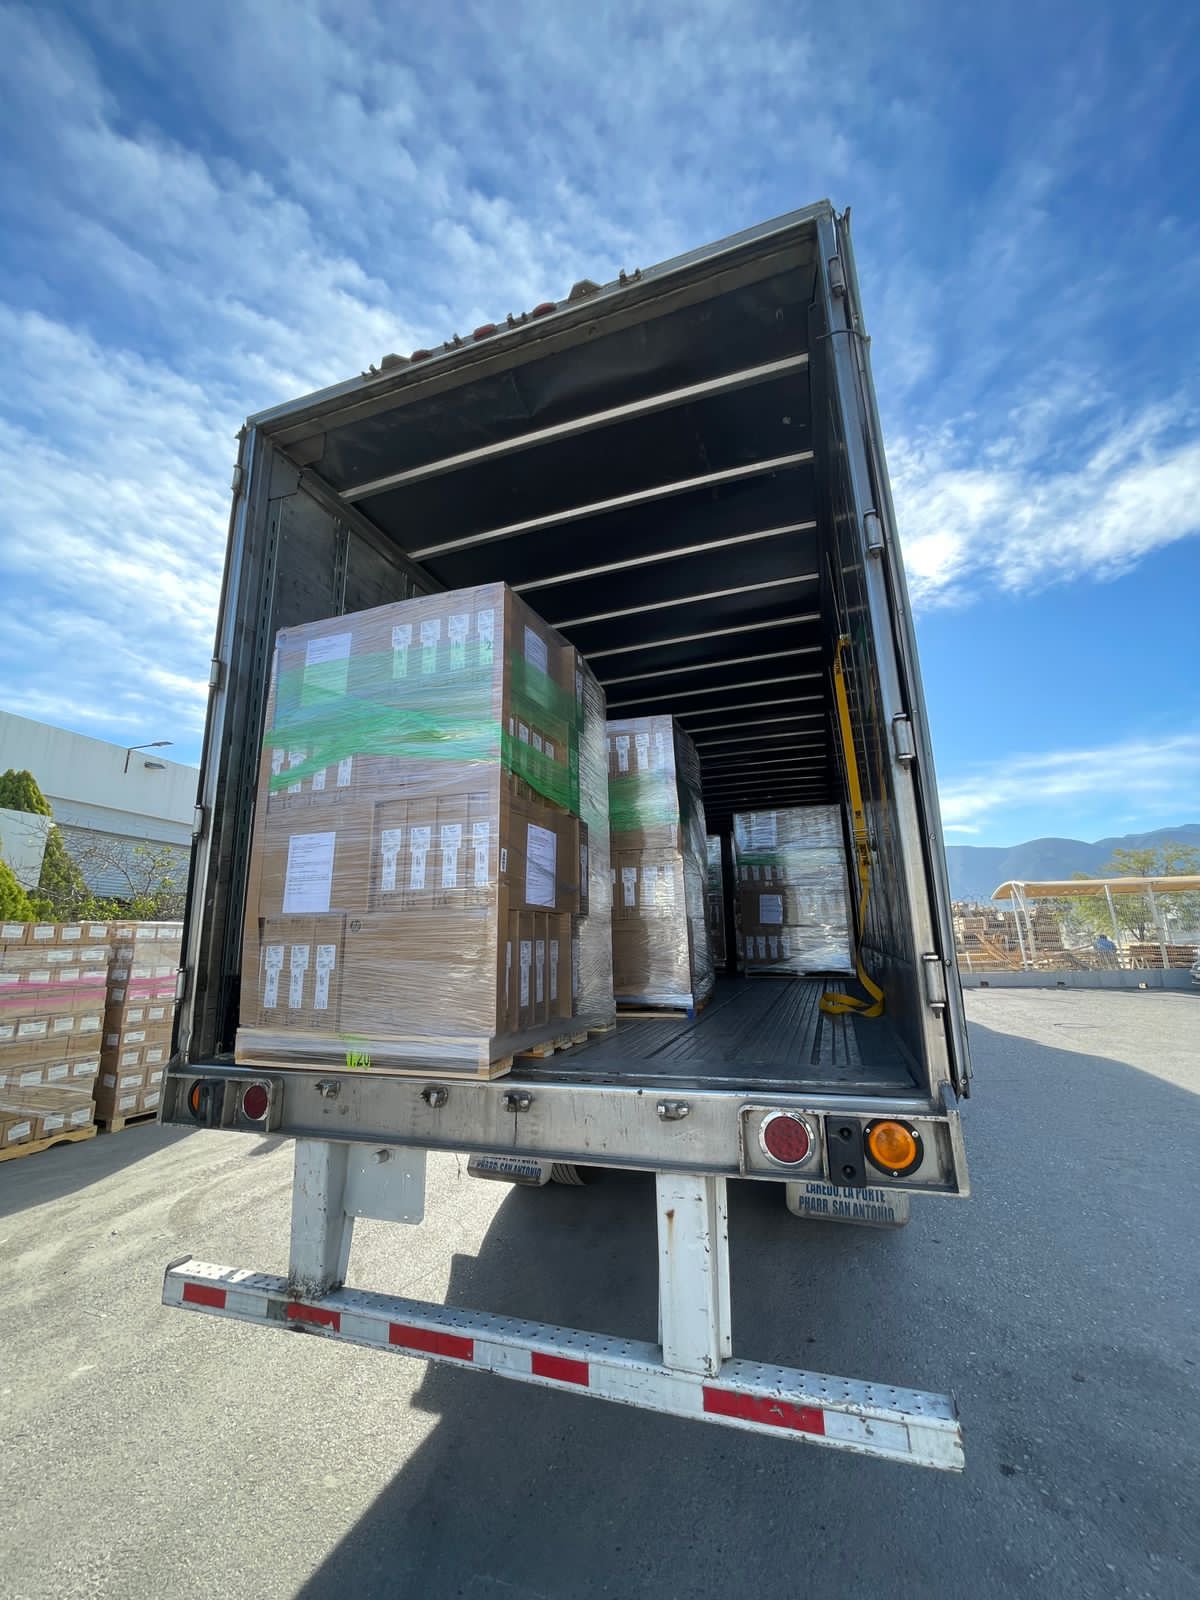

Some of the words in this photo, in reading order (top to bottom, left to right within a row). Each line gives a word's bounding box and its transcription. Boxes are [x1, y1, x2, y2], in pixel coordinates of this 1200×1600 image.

[844, 1187, 855, 1199] LA
[855, 1187, 886, 1203] PORTE
[832, 1200, 851, 1217] SAN
[853, 1202, 895, 1222] ANTONIO
